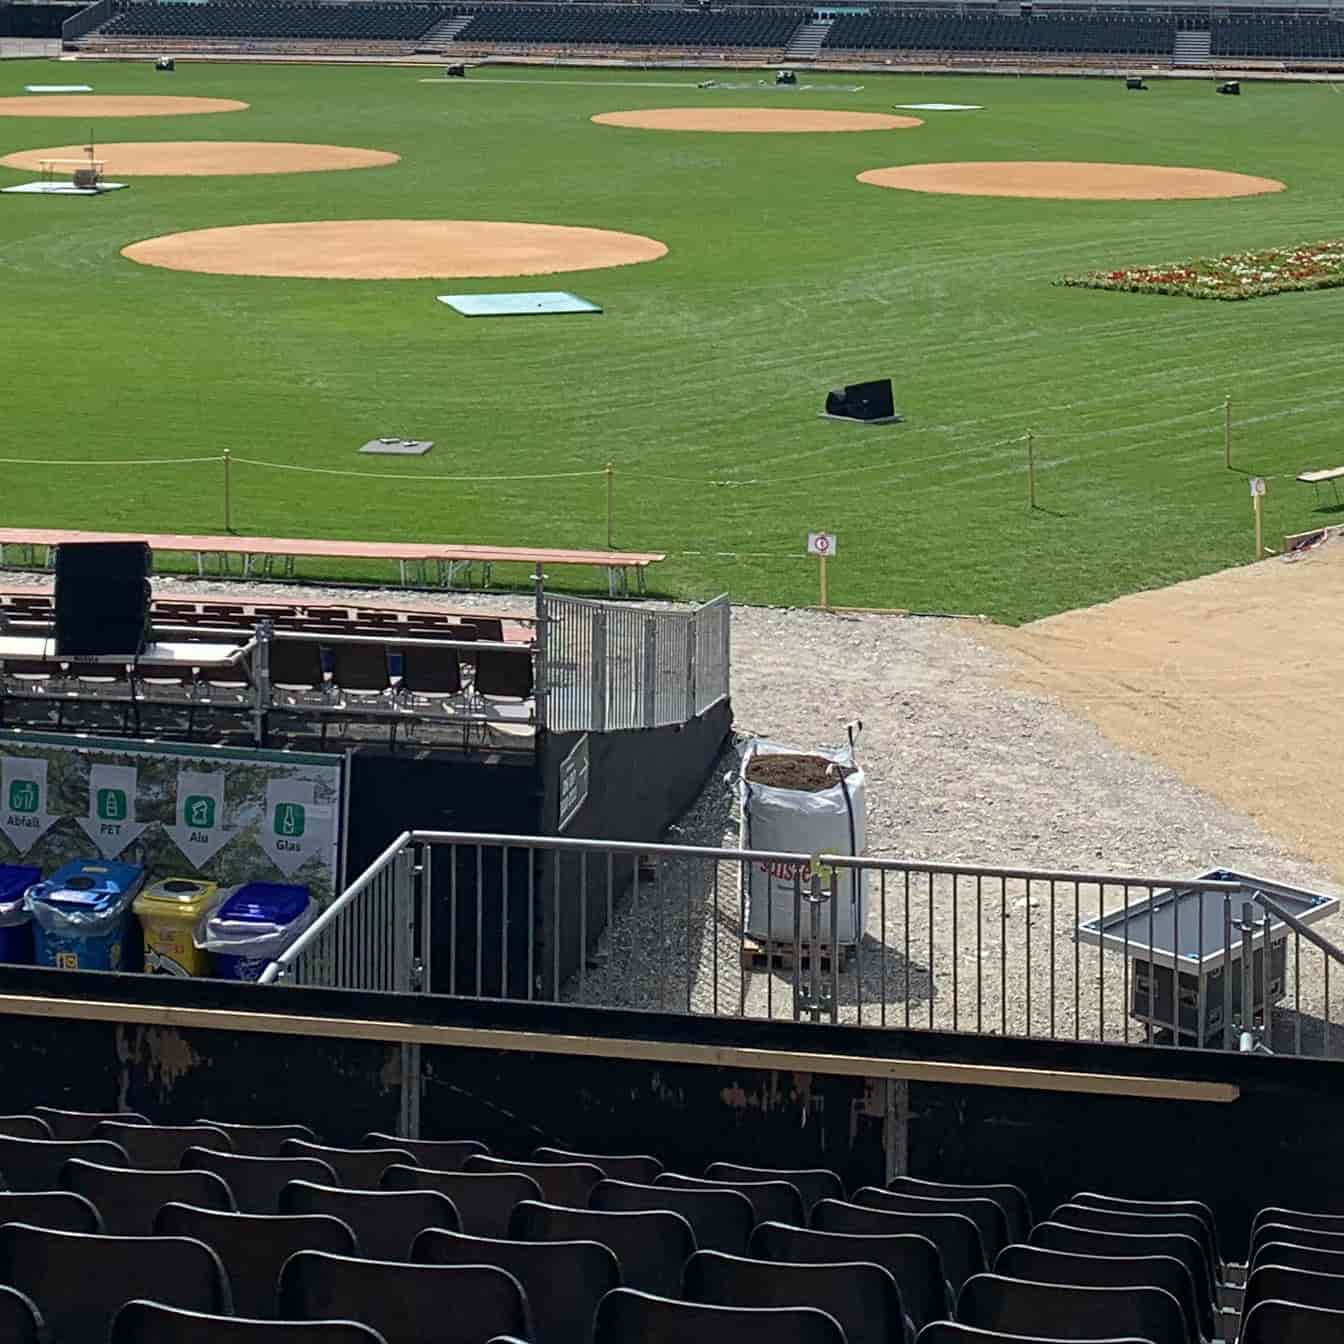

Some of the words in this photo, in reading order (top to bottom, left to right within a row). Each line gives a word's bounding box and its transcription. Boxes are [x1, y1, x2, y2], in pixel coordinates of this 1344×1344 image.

[6, 814, 41, 829] Abfall
[99, 822, 122, 836] PET
[189, 830, 209, 843] Alu
[275, 839, 302, 852] Glas
